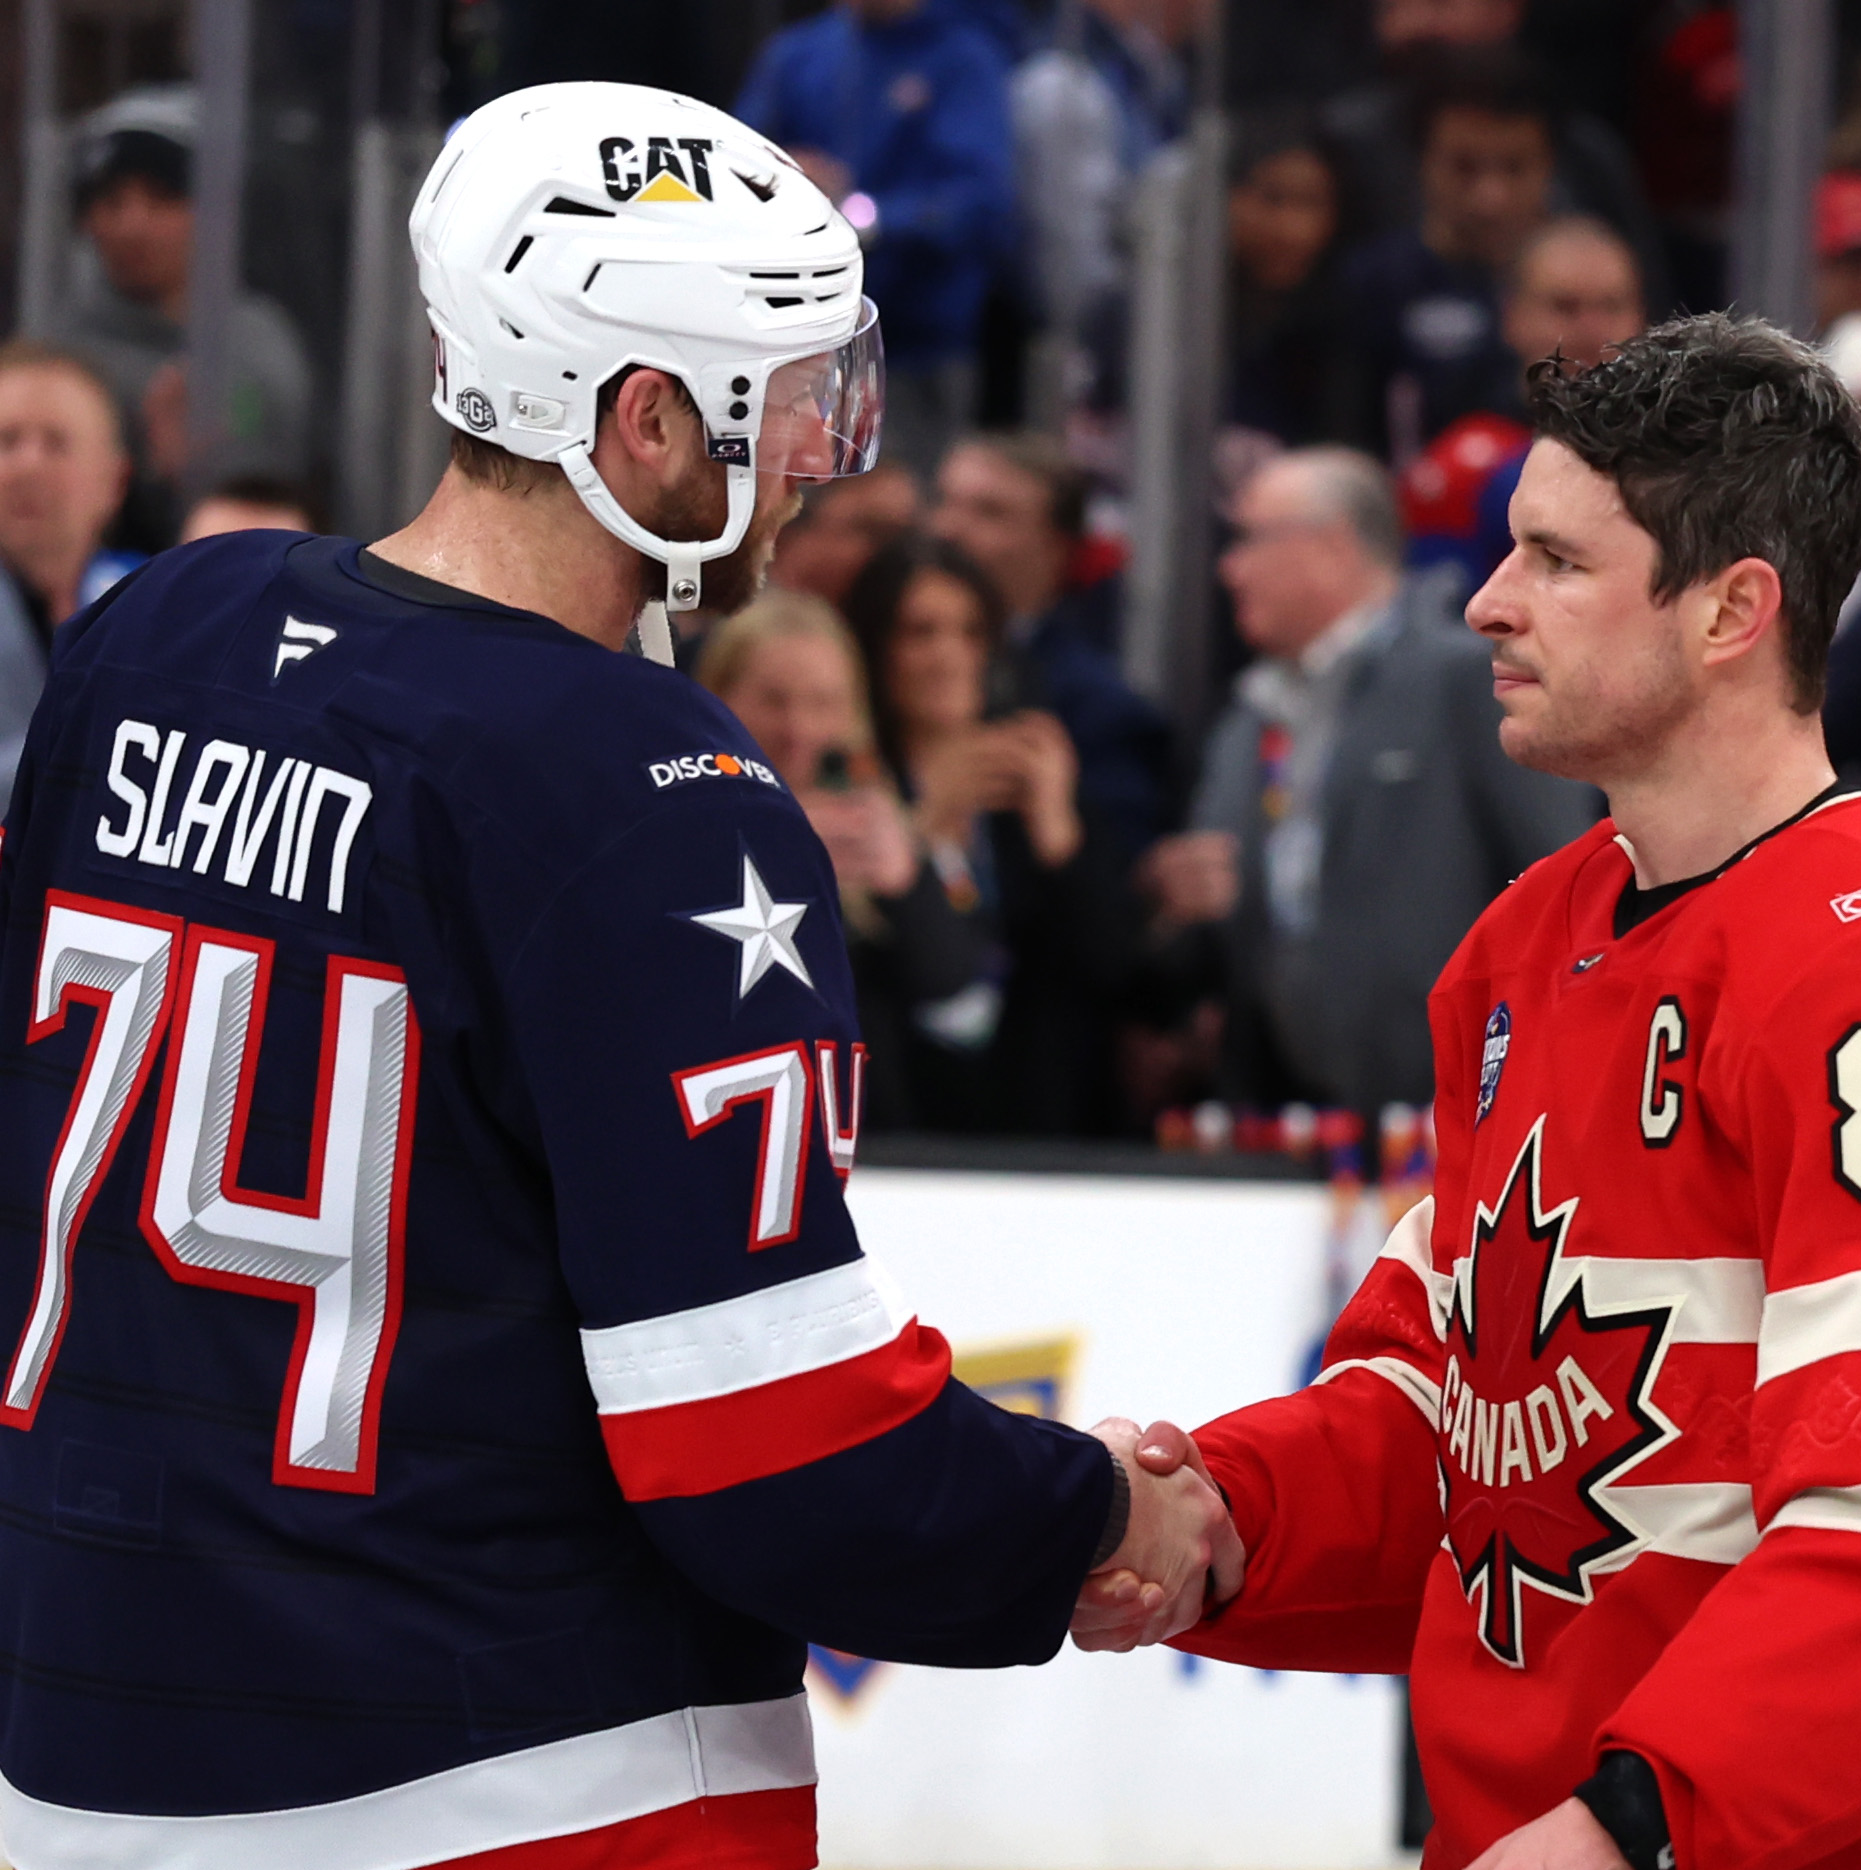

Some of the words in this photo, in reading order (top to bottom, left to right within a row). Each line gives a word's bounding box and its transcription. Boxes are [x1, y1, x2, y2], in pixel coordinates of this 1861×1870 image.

[599, 137, 713, 202] CAT
[95, 719, 373, 914] SLAVIN
[670, 1039, 870, 1253] 74
[1640, 994, 1688, 1150] C
[0, 889, 422, 1496] 74
[1443, 1354, 1614, 1487] CANADA
